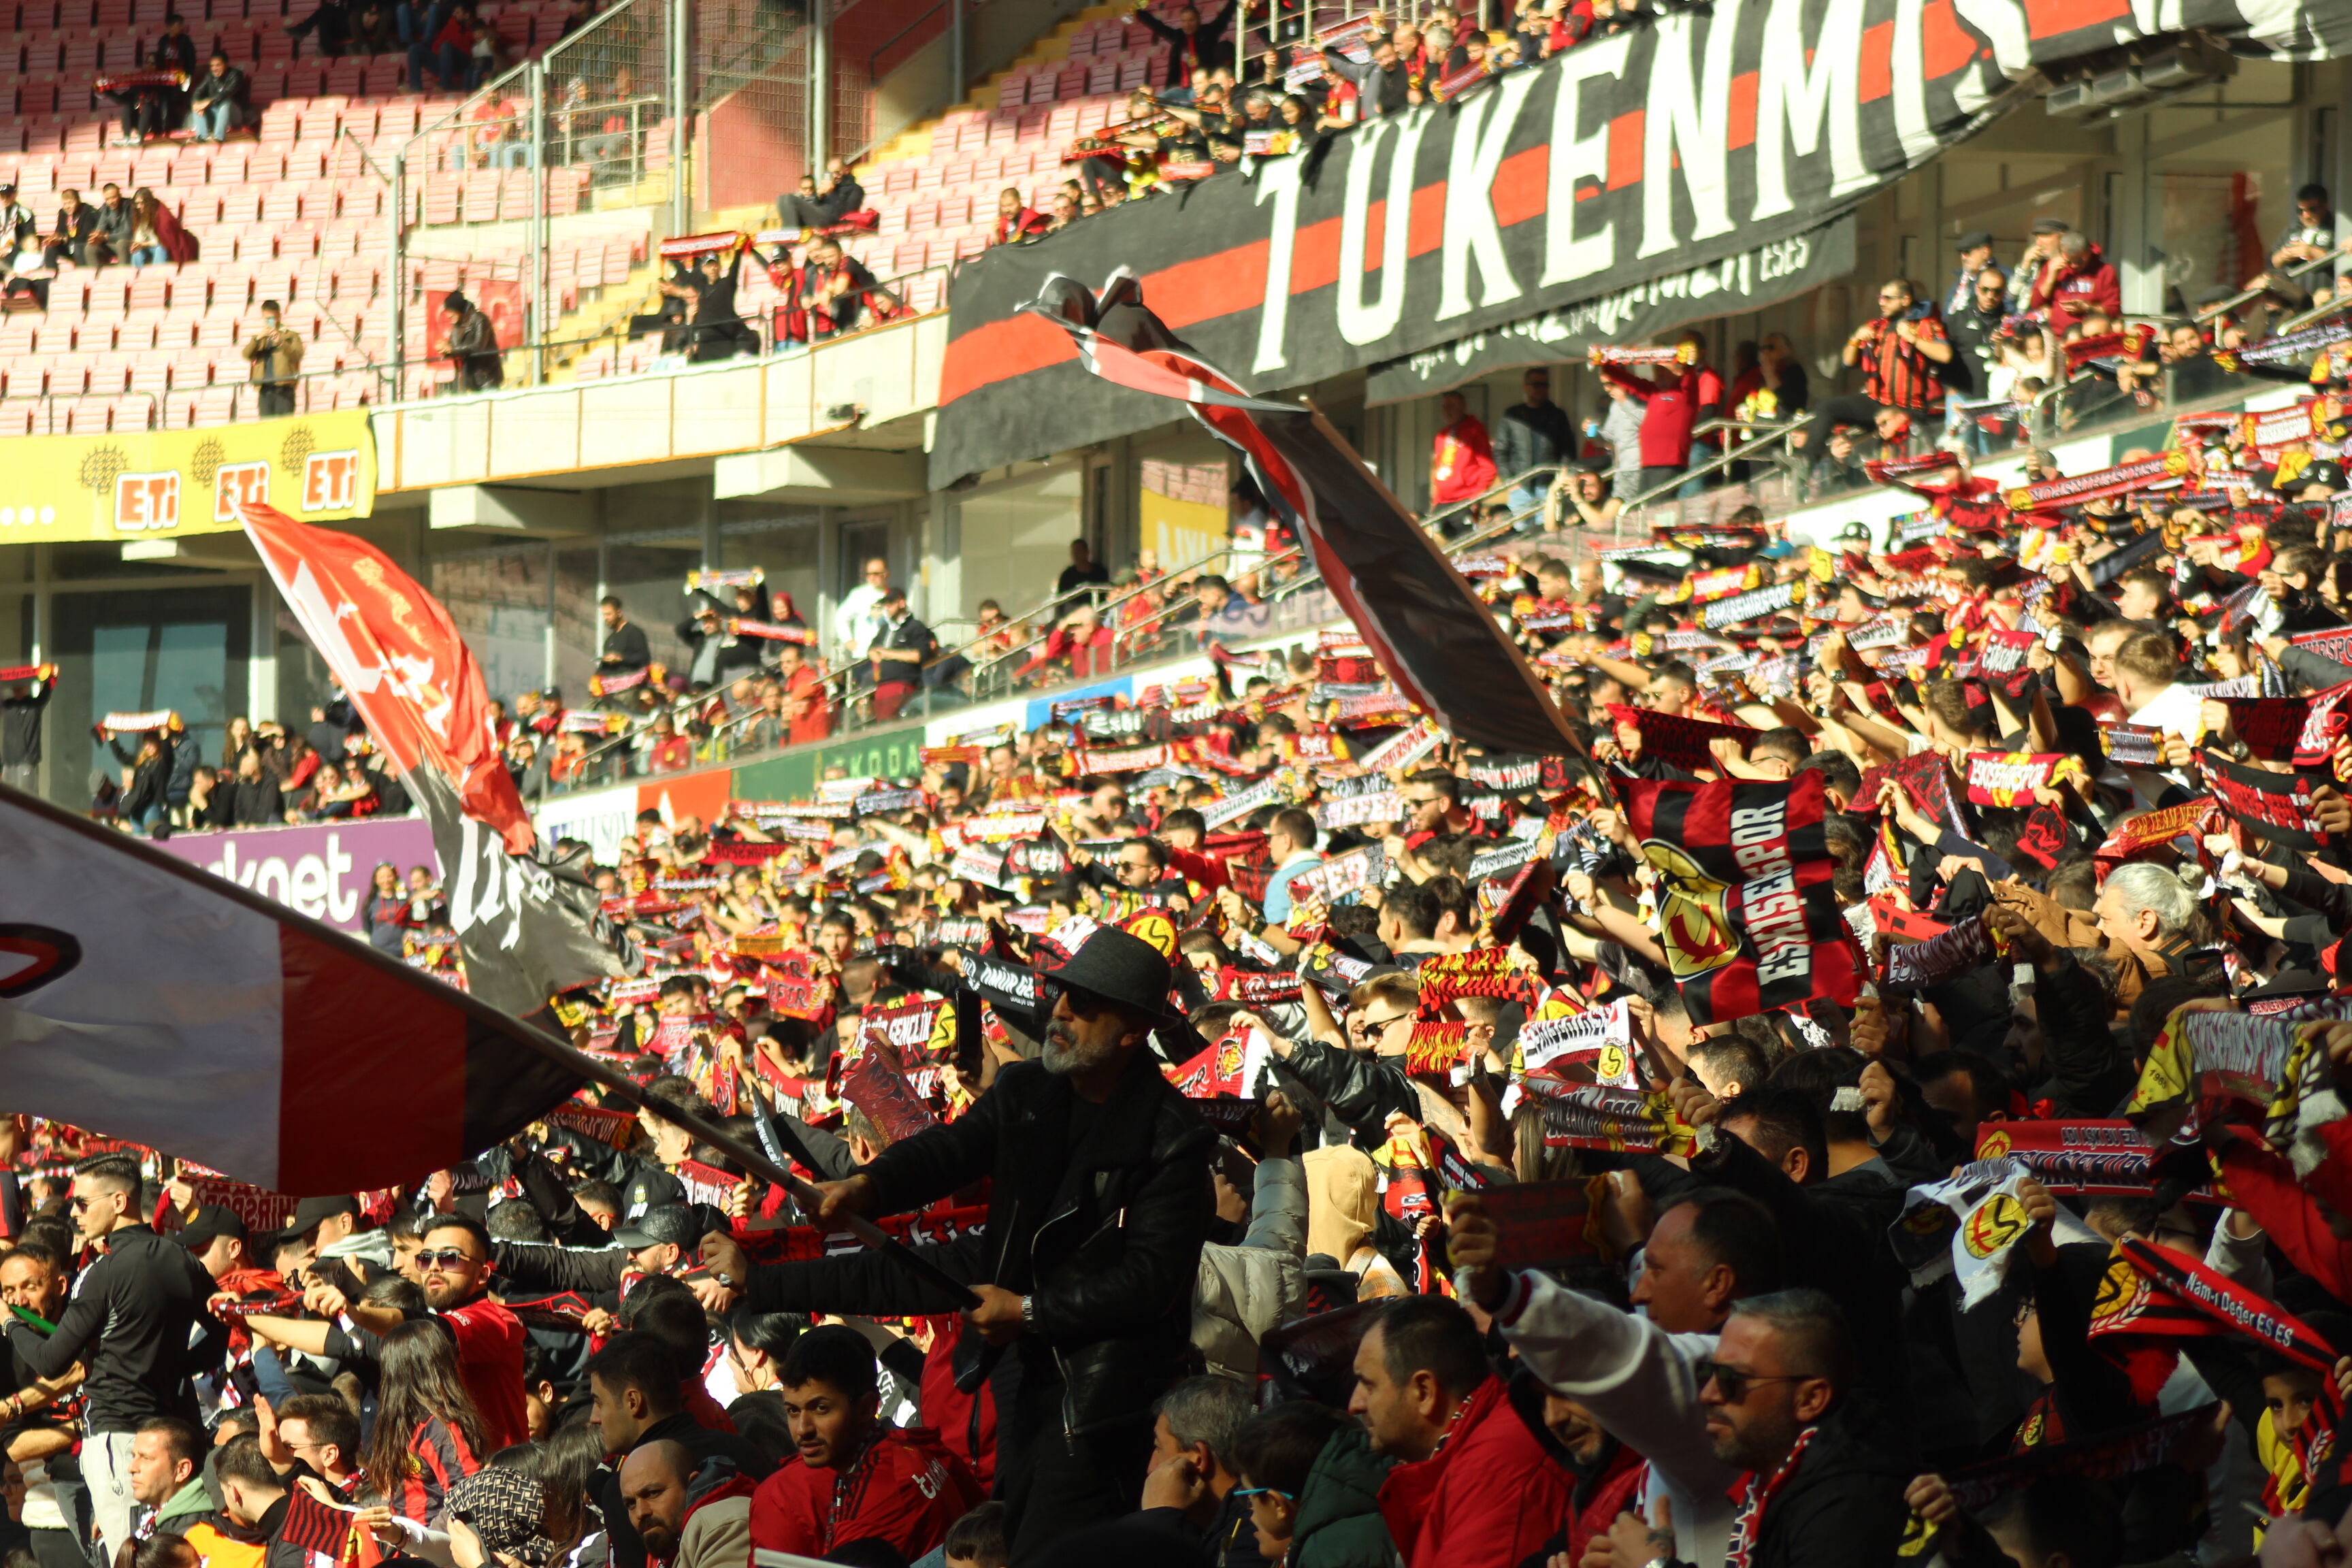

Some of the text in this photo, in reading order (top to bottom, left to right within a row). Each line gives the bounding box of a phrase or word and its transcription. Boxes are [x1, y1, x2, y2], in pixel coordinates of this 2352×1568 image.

[2221, 1291, 2255, 1327] Değer
[2256, 1313, 2274, 1337] ES
[2274, 1323, 2294, 1348] ES
